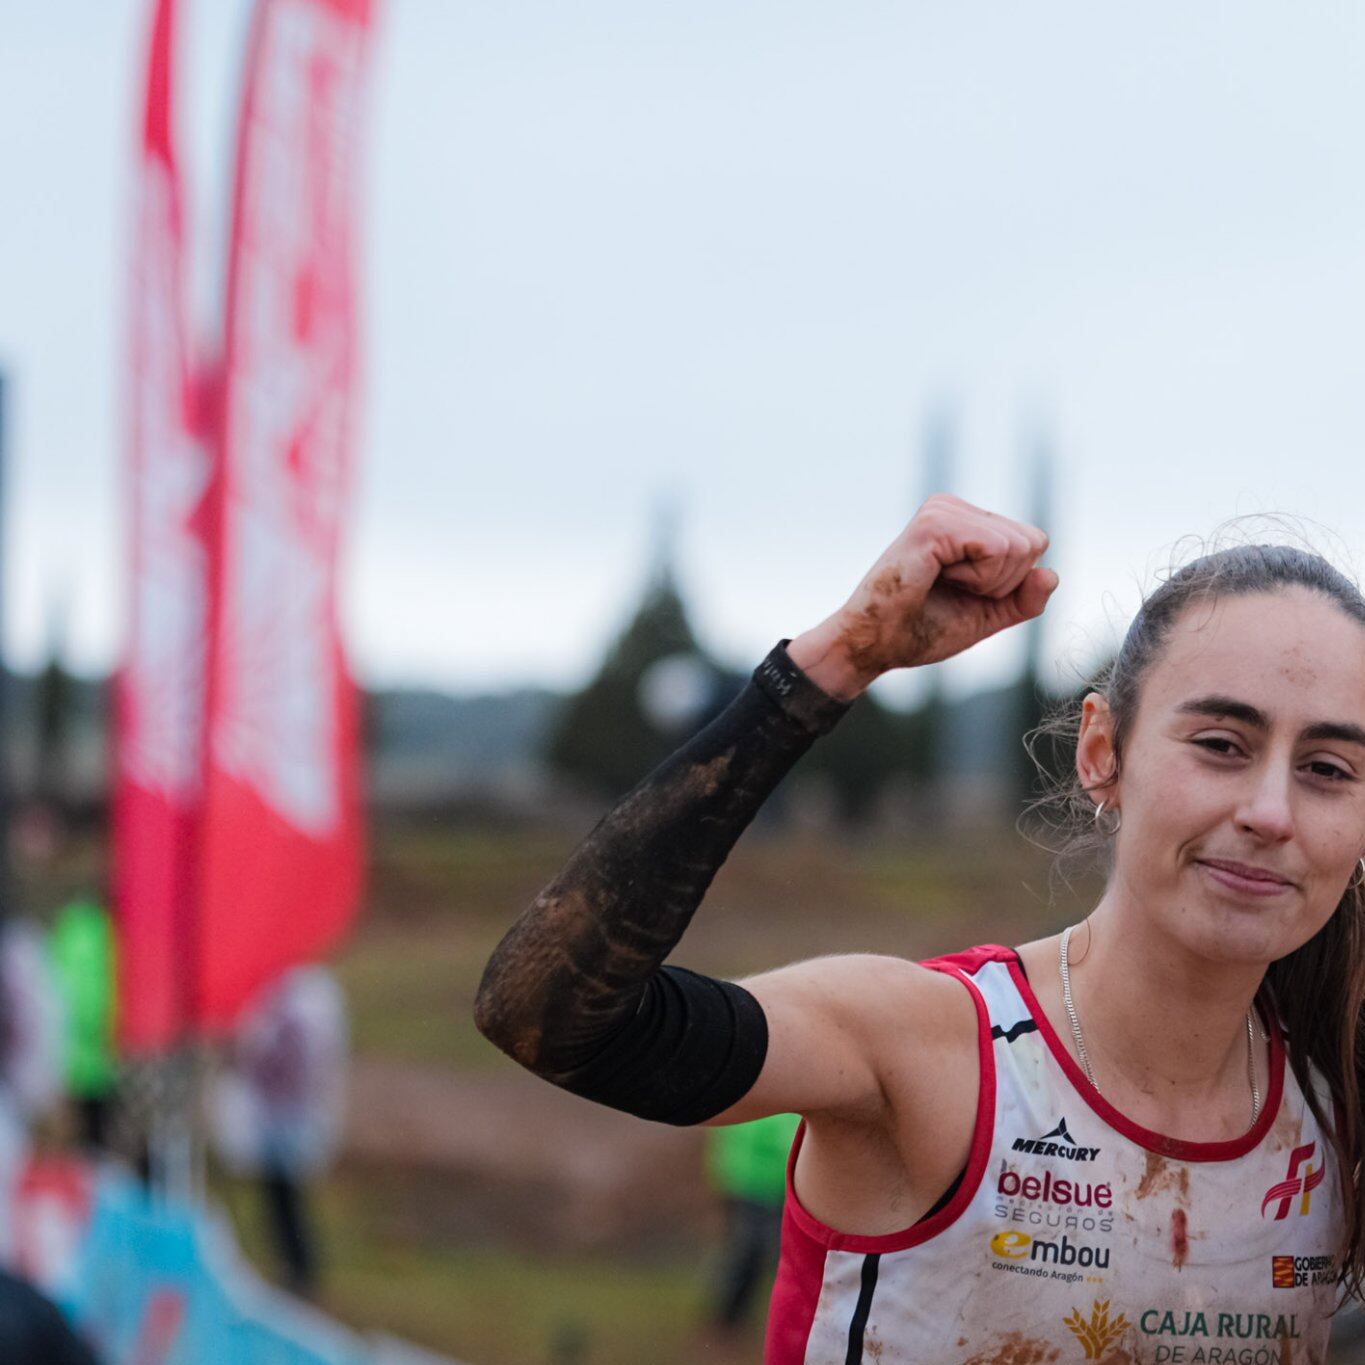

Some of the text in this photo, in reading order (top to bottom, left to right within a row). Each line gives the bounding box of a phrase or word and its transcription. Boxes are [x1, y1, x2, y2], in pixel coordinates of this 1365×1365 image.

[1011, 1138, 1101, 1161] MERCURY
[995, 1204, 1114, 1232] SEGUROS
[990, 1231, 1110, 1268] embou
[992, 1262, 1084, 1283] conectando Aragón
[1295, 1273, 1309, 1287] DE
[1140, 1310, 1300, 1340] CAJA RURAL
[1156, 1345, 1182, 1364] DE
